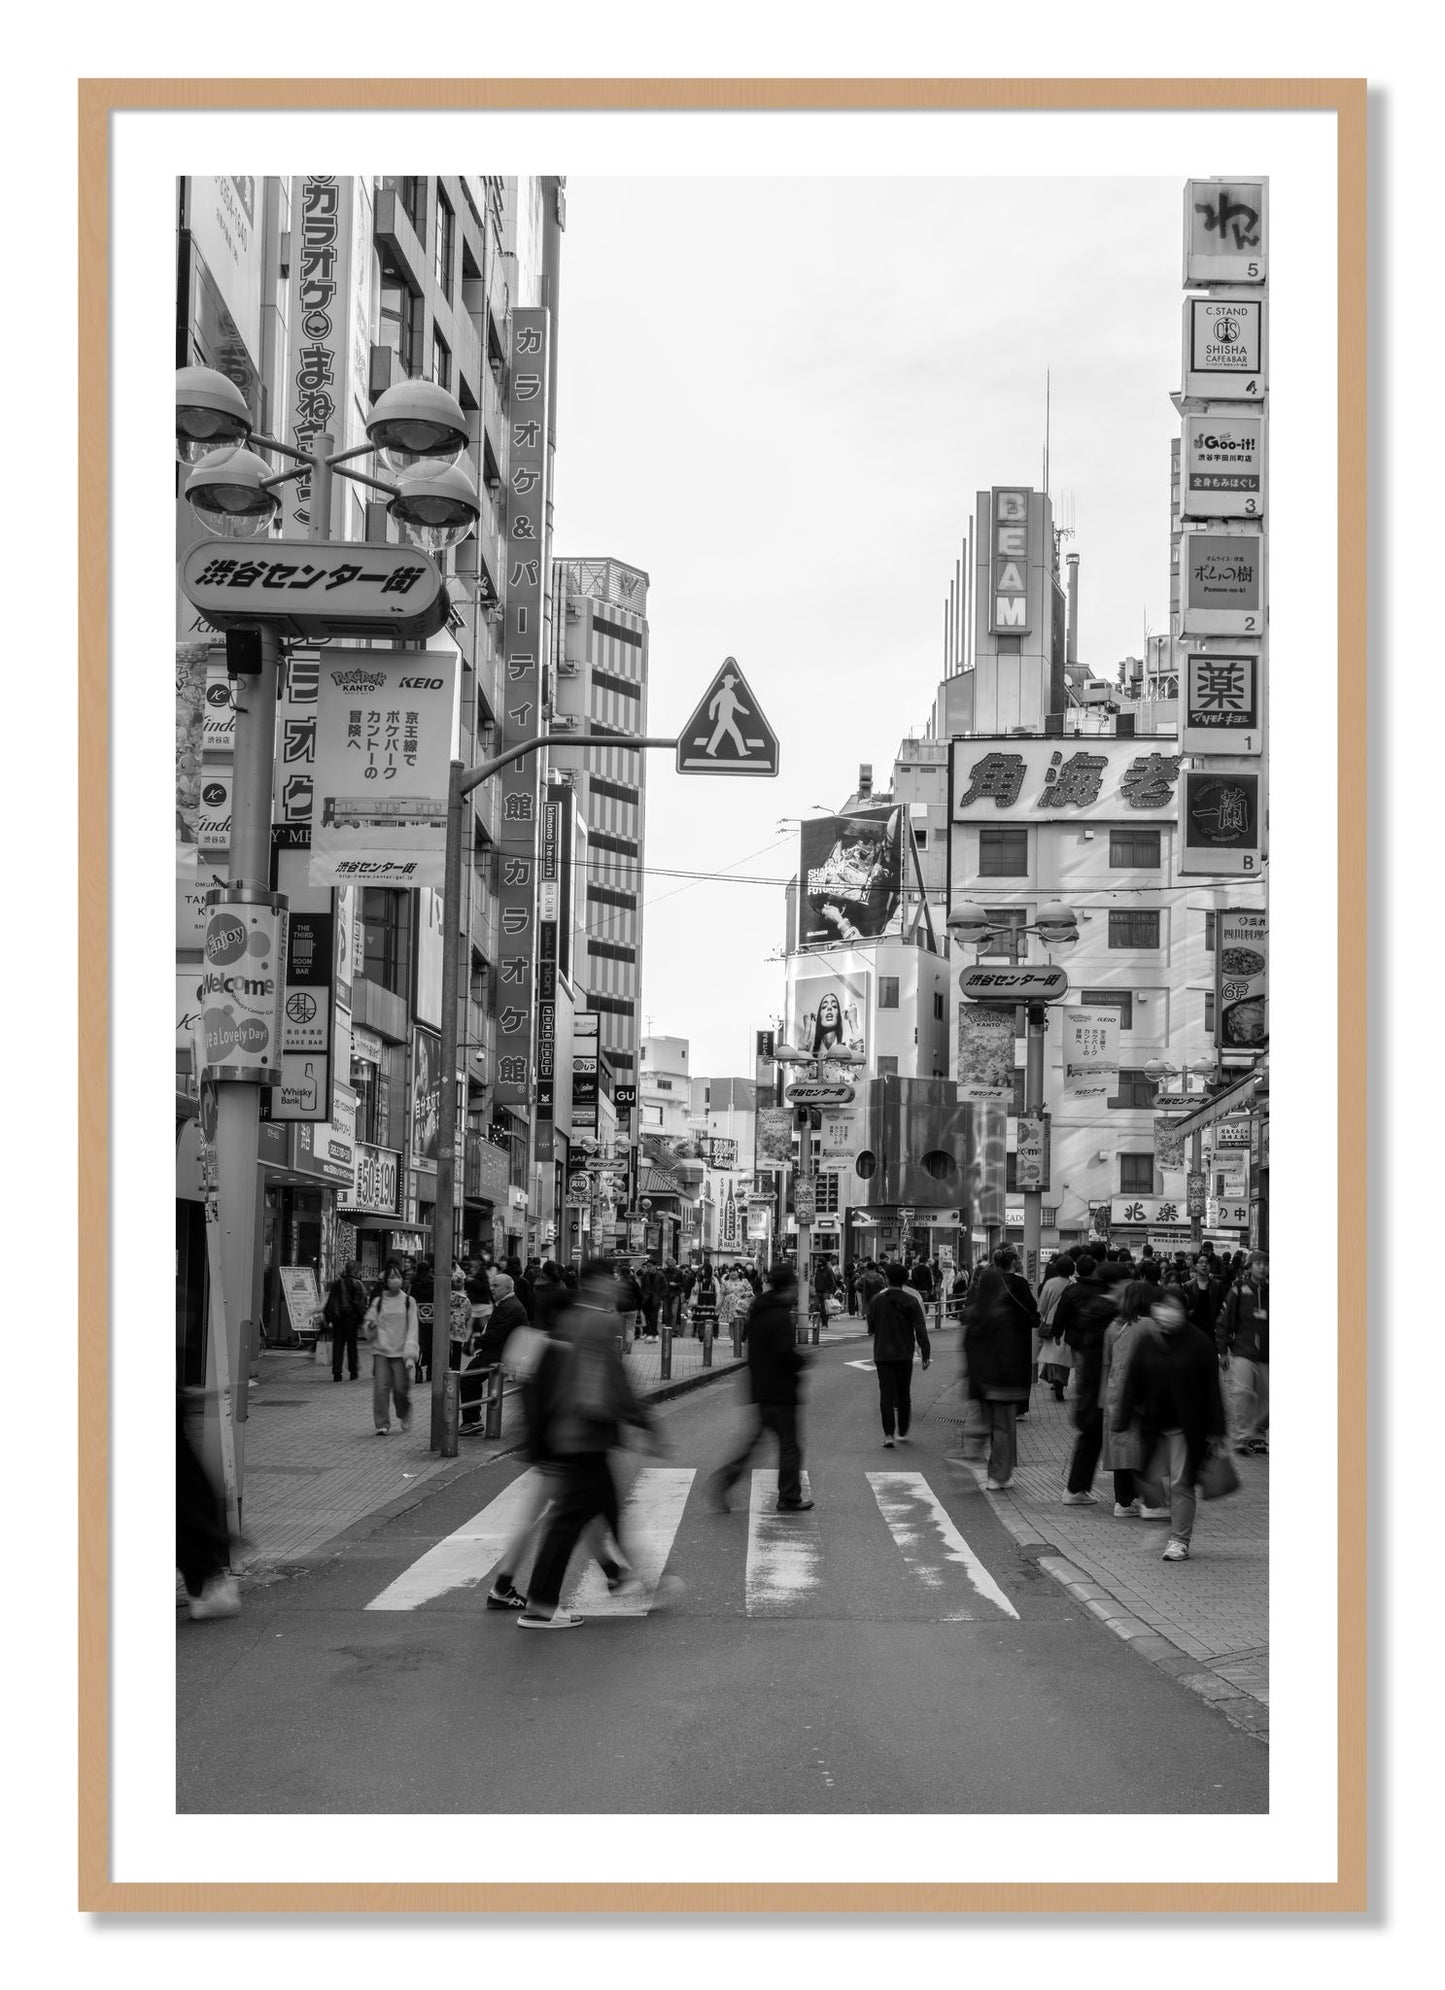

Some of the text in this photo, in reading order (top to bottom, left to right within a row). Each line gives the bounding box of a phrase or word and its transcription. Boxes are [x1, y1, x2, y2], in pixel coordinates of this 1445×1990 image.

[299, 184, 340, 313] カラオケ
[1247, 262, 1259, 277] 5
[1206, 306, 1248, 316] C.STAND
[1206, 345, 1248, 355] SHISHA
[1206, 355, 1248, 363] CAFE&BAR
[1204, 435, 1255, 450] Goo-it!
[1193, 477, 1257, 489] 全身もみほぐし
[1245, 499, 1256, 514] 3
[996, 491, 1027, 626] BEAM
[195, 558, 427, 595] 渋谷センター街
[1244, 616, 1256, 632] 2
[342, 684, 376, 692] KANTO
[398, 676, 445, 691] KEIO
[1197, 662, 1245, 709] 薬
[347, 710, 362, 750] 冒険へ
[364, 710, 381, 780] カントーの
[383, 710, 400, 780] ポケパーク
[403, 711, 419, 767] 京王線で
[1244, 735, 1252, 751] 1
[960, 751, 1181, 808] 角海老
[1192, 787, 1249, 833] 一蘭
[546, 806, 555, 840] kimono
[203, 835, 226, 844] 渋谷店
[335, 861, 418, 874] 渋谷センター街
[1243, 855, 1255, 870] B
[207, 926, 244, 958] Enjoy
[498, 857, 532, 1085] カラオケ館
[203, 972, 274, 997] Welcome
[966, 974, 1062, 987] 渋谷センター街
[1222, 982, 1249, 1001] 6F
[218, 1027, 247, 1044] Lovely
[248, 1027, 267, 1041] Day!
[281, 1087, 312, 1098] Whisky
[616, 1091, 635, 1101] GU
[789, 1089, 846, 1097] 渋谷センター街
[281, 1097, 300, 1105] Bank
[1124, 1201, 1180, 1222] 兆楽
[726, 1200, 736, 1240] BEER
